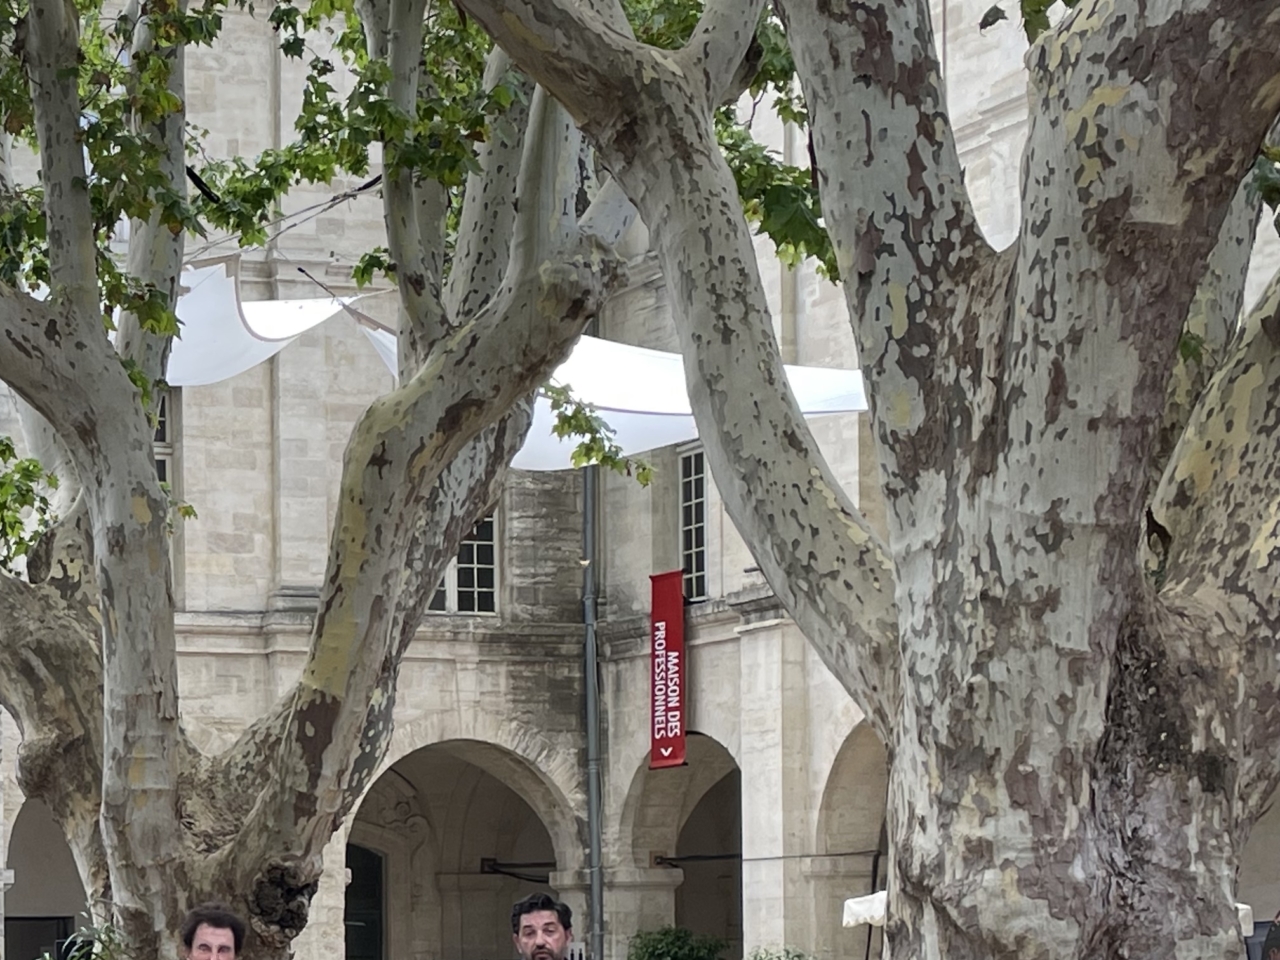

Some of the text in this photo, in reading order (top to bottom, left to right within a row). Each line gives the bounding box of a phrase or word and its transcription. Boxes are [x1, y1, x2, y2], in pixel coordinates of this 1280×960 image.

[654, 621, 666, 740] PROFESSIONNELS
[667, 651, 681, 738] MAISON DES
